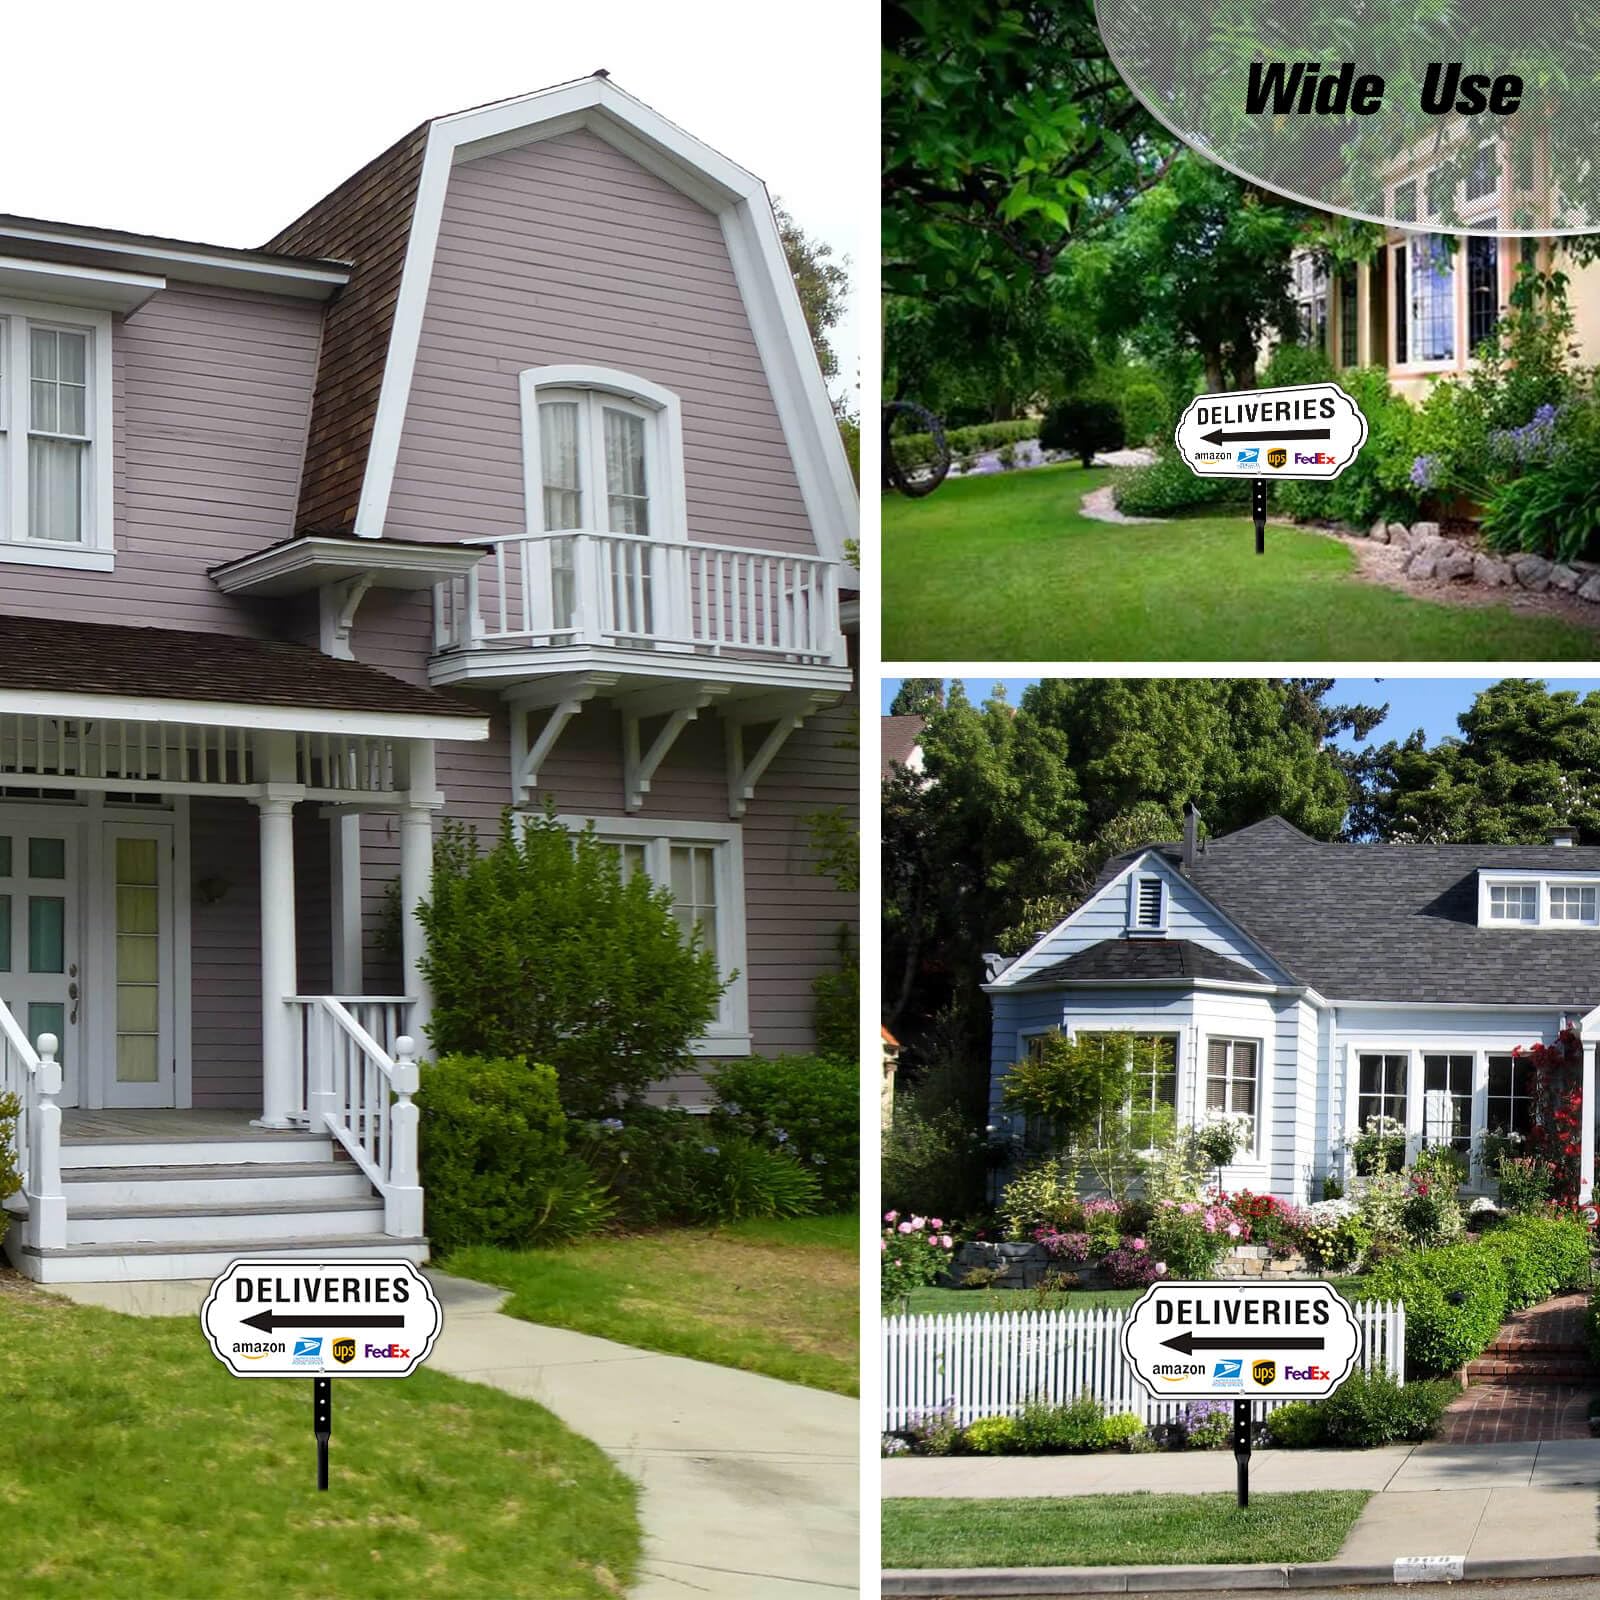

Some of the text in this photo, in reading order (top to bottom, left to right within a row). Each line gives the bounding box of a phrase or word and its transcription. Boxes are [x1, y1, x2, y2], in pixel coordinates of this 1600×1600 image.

[1197, 397, 1336, 425] DELIVERIES
[1194, 451, 1336, 466] amazon ups FedEx
[236, 1277, 410, 1303] DELIVERIES
[1156, 1299, 1330, 1325] DELIVERIES
[232, 1342, 411, 1359] amazon ups FedEx
[1152, 1363, 1330, 1381] amazon ups FedEx
